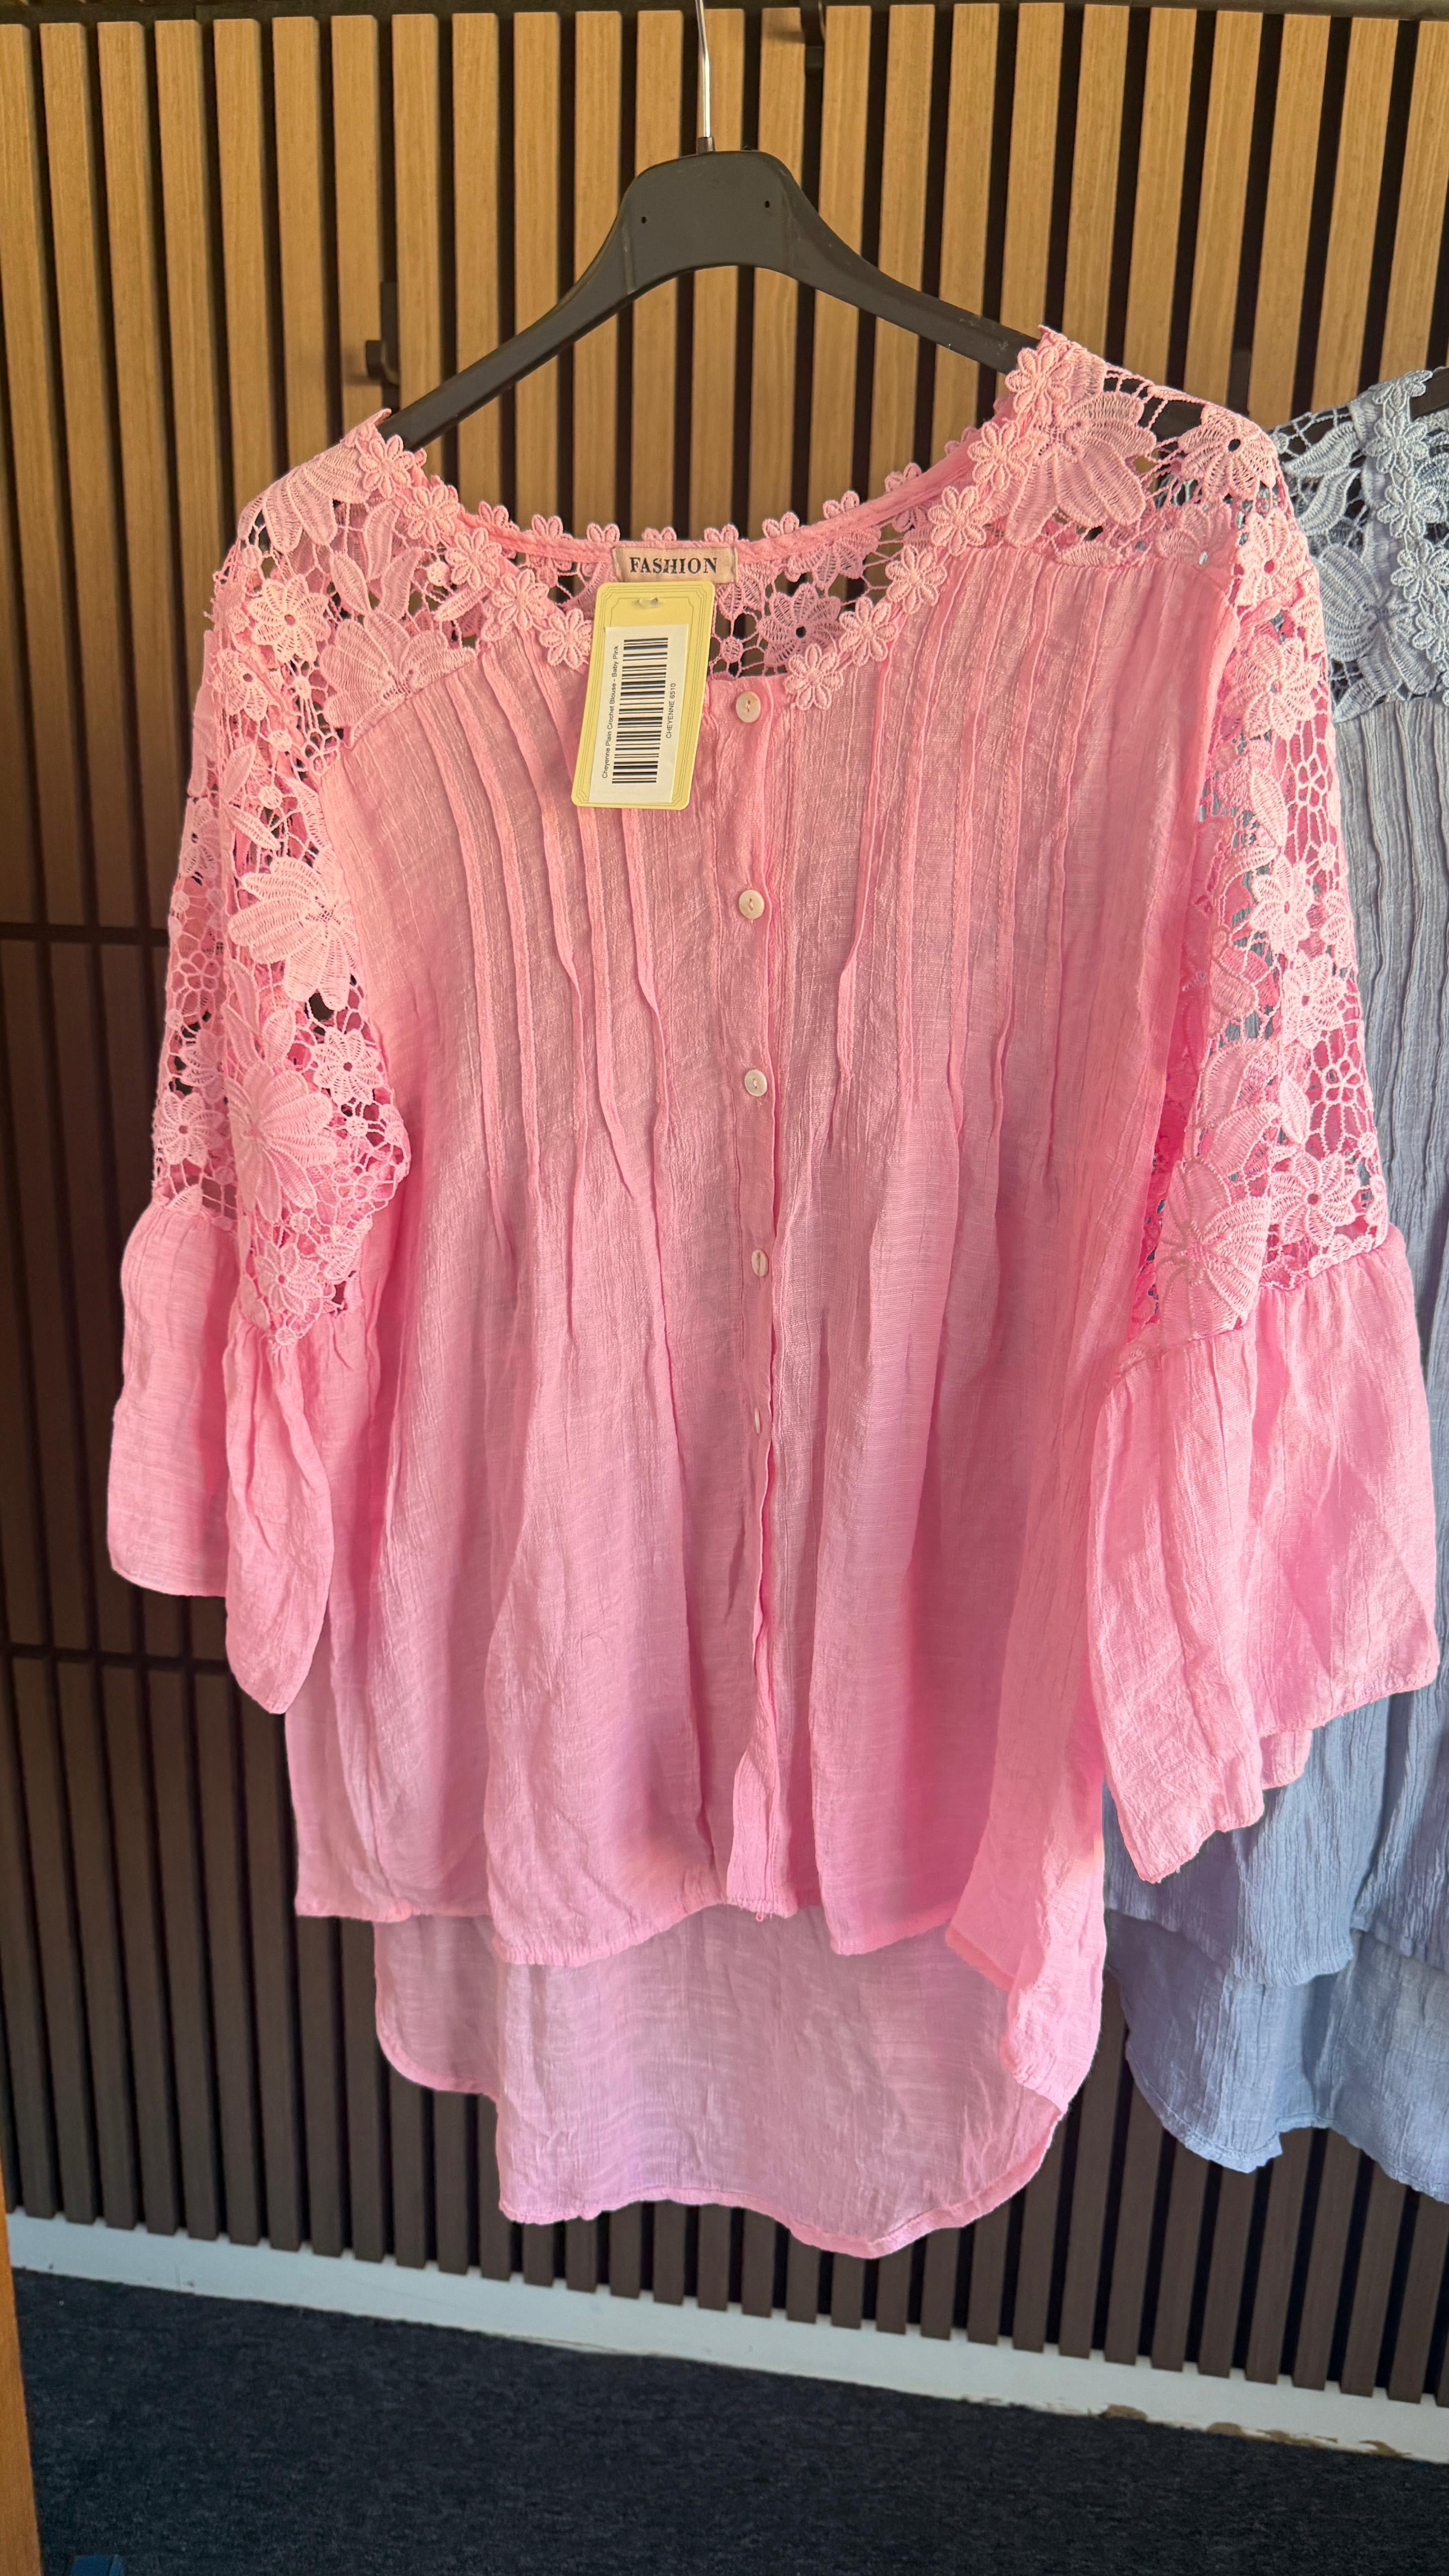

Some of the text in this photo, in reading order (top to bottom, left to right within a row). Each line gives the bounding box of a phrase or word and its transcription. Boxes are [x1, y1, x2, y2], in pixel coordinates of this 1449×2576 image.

[629, 556, 717, 574] FASHION
[602, 748, 611, 779] Cheyenne
[609, 683, 617, 704] Blouse
[666, 700, 675, 739] CHEYENNE
